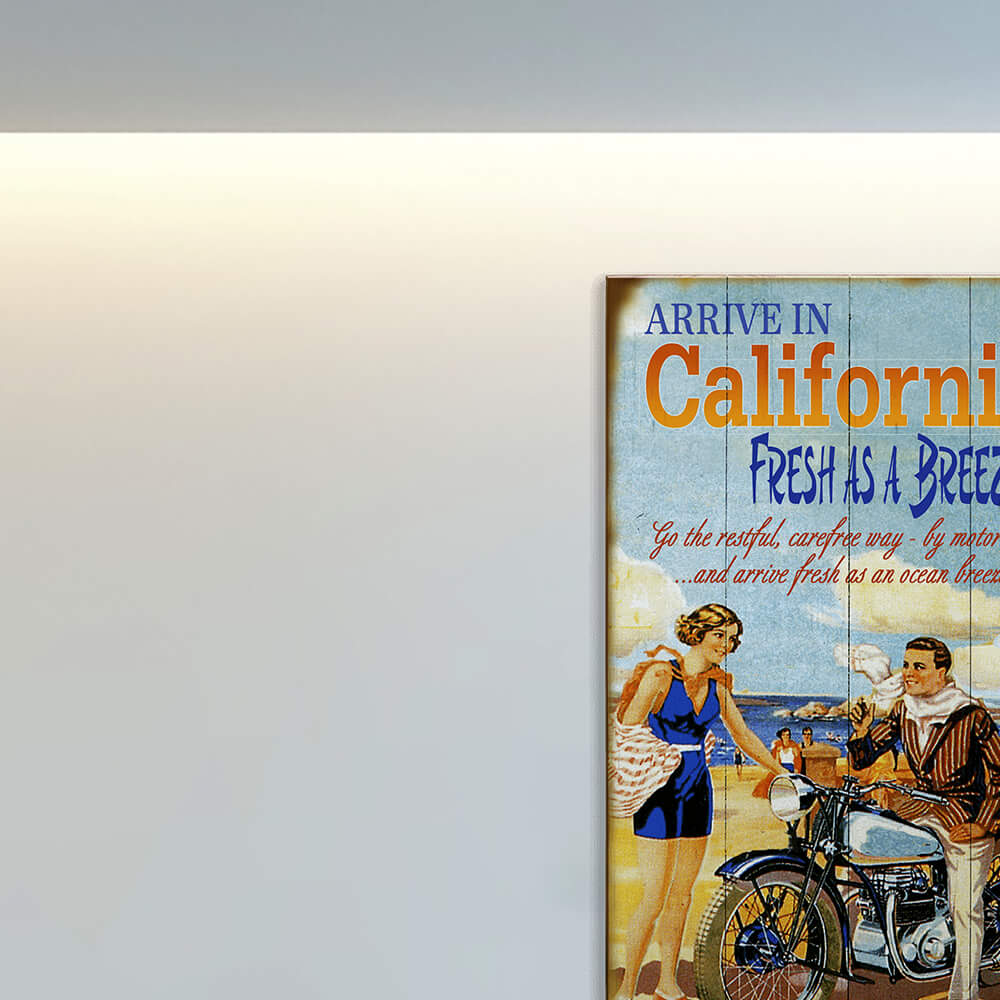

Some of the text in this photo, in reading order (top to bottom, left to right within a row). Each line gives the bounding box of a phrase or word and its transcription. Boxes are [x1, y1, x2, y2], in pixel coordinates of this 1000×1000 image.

[645, 303, 832, 335] ARRIVE IN
[884, 445, 901, 505] A
[652, 520, 680, 559] Go
[684, 517, 712, 547] the
[719, 517, 783, 560] restful,
[788, 517, 861, 560] carefree
[865, 530, 904, 560] way
[922, 517, 945, 560] by
[733, 562, 791, 584] arrive
[787, 555, 840, 596] fresh
[845, 567, 867, 584] as
[871, 567, 895, 584] an
[899, 567, 949, 584] ocean
